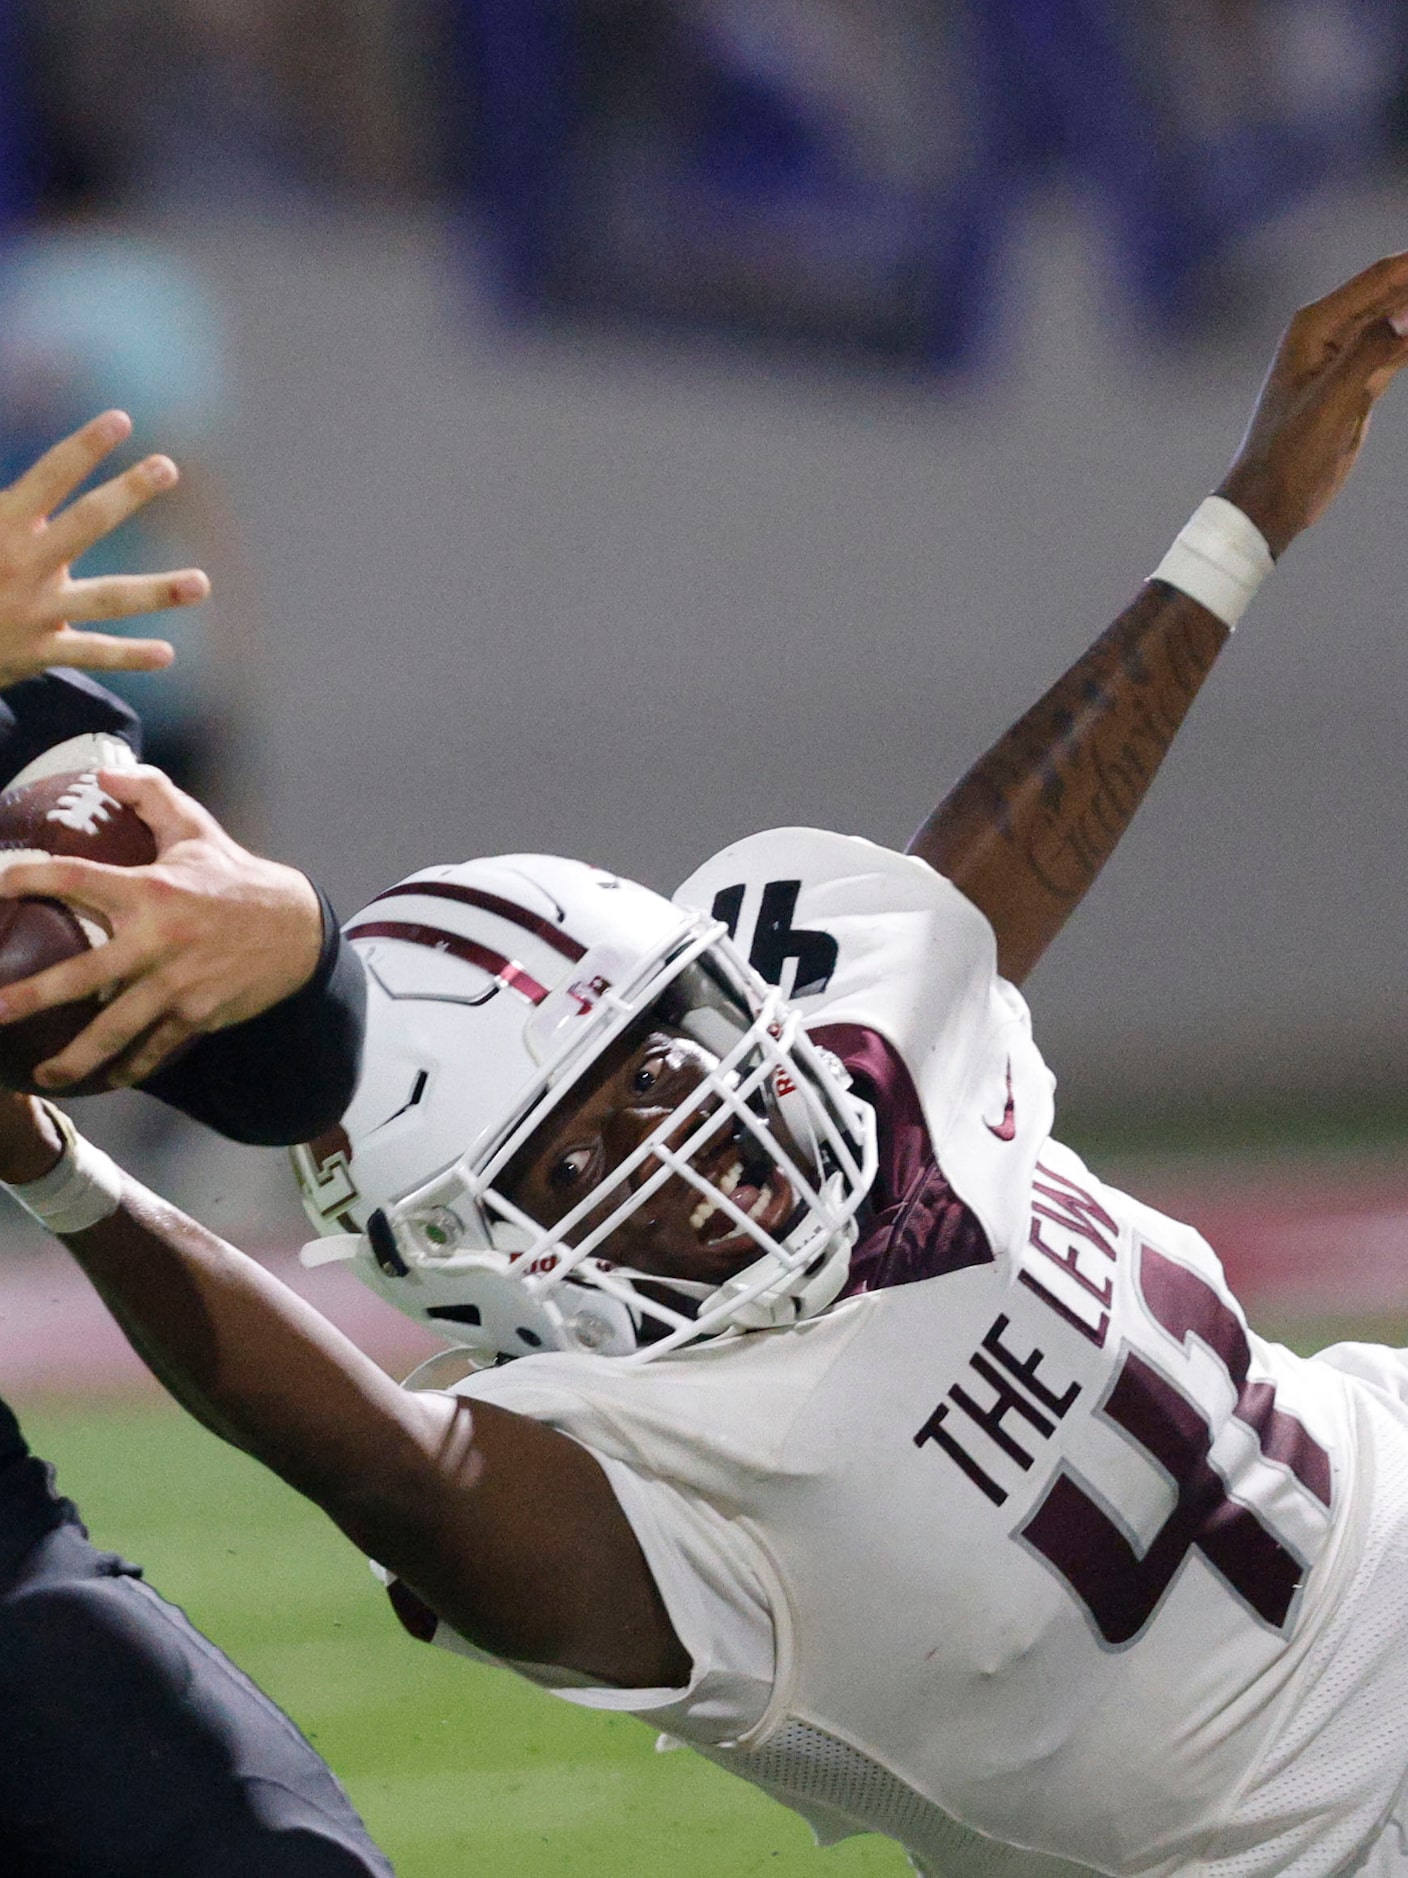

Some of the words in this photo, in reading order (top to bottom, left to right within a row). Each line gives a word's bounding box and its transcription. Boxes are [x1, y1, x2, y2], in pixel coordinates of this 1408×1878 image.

[913, 1312, 1083, 1508] THE
[1016, 1159, 1120, 1350] LEW
[1008, 1226, 1335, 1655] 41
